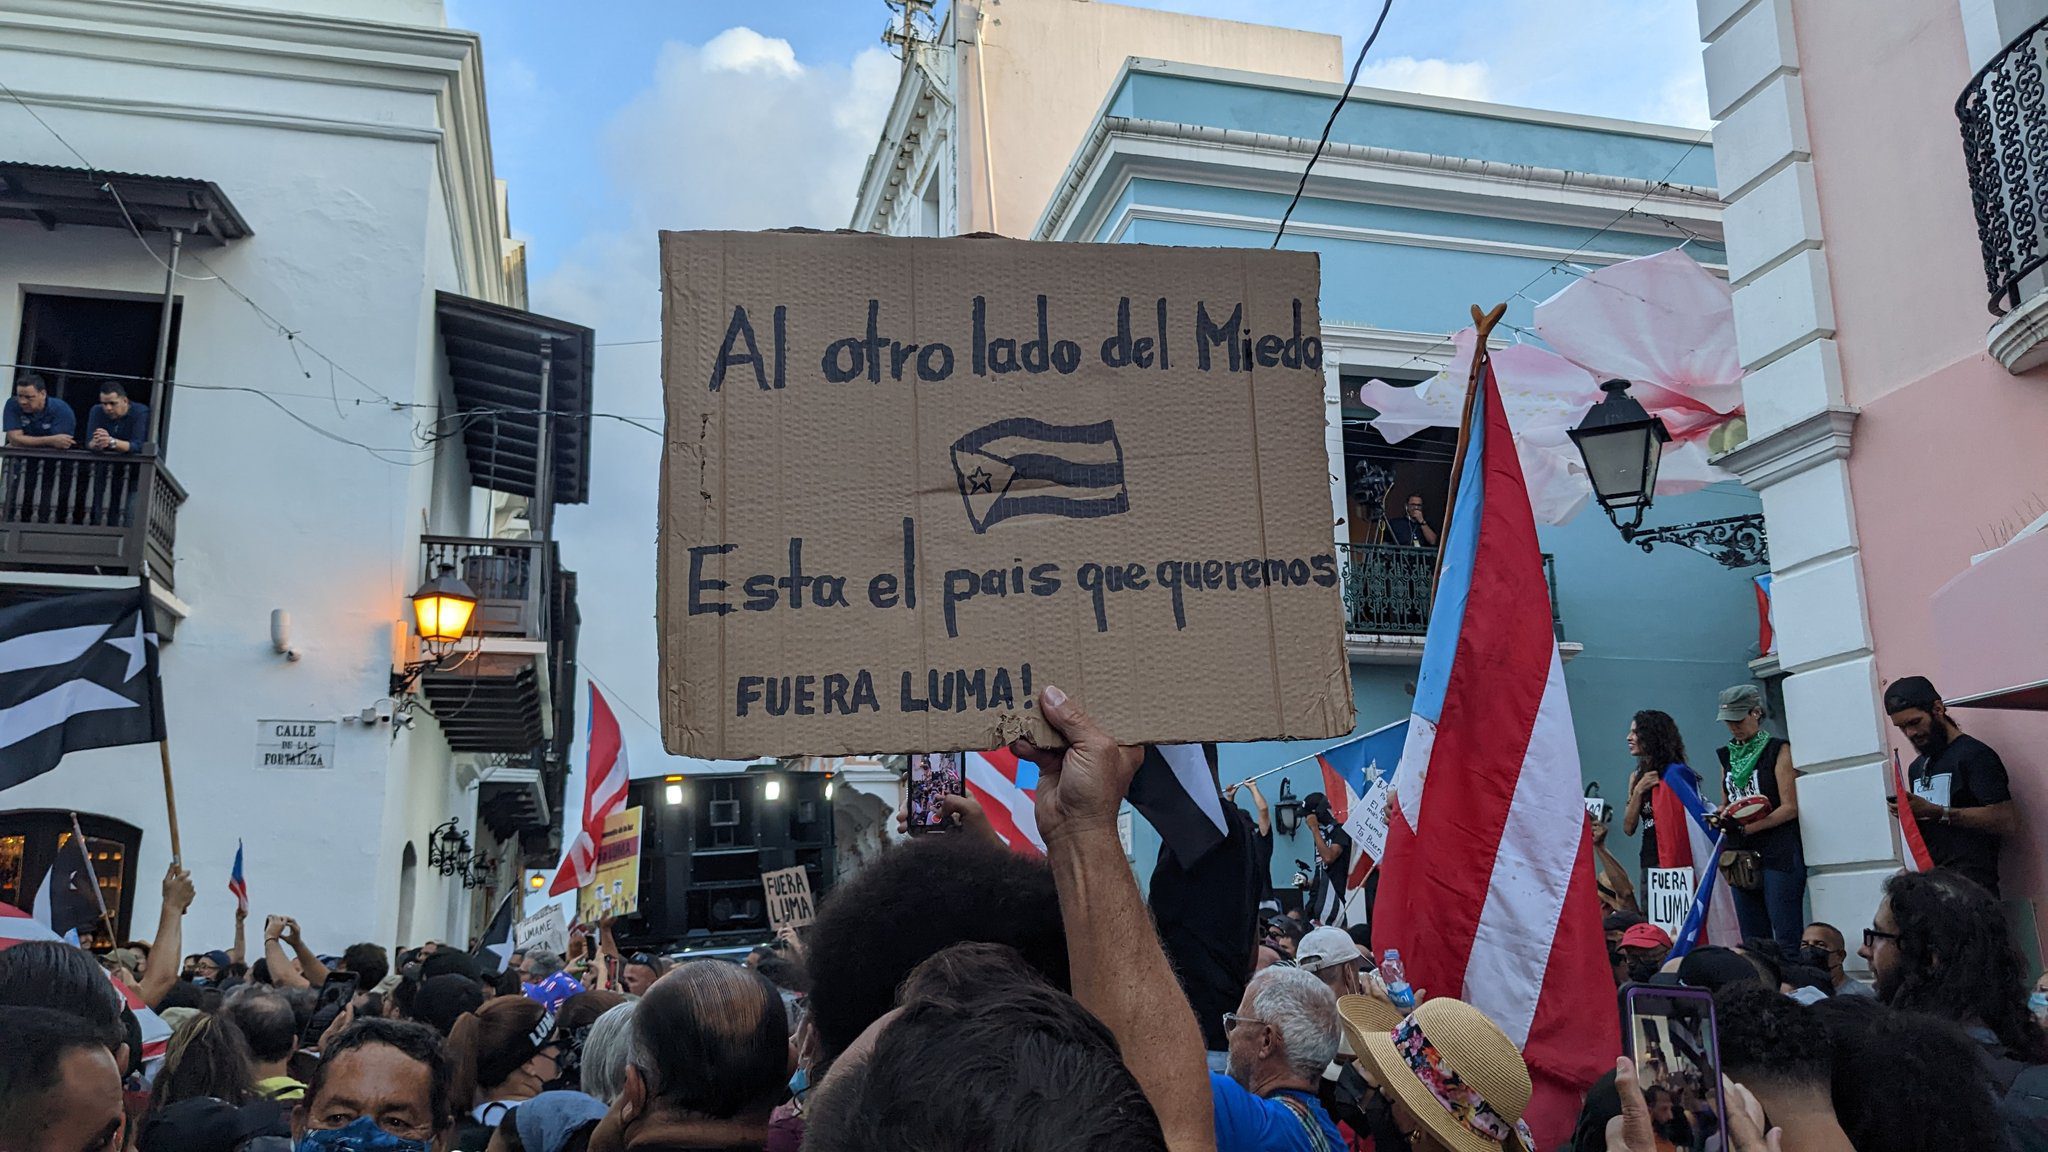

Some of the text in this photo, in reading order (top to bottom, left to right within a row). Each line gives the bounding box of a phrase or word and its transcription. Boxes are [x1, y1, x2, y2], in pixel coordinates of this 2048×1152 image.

[708, 294, 1323, 393] Al otro lado del Miedo
[687, 516, 1339, 639] Esta el pais que queremos
[736, 663, 1034, 718] FUERA LUMA!
[275, 725, 317, 737] CALLE
[281, 741, 308, 751] DE LA
[766, 871, 807, 897] FUERA
[1651, 871, 1688, 892] FUERA
[770, 896, 813, 923] LUMA
[1654, 892, 1690, 927] LUMA
[529, 1011, 556, 1047] LUM
